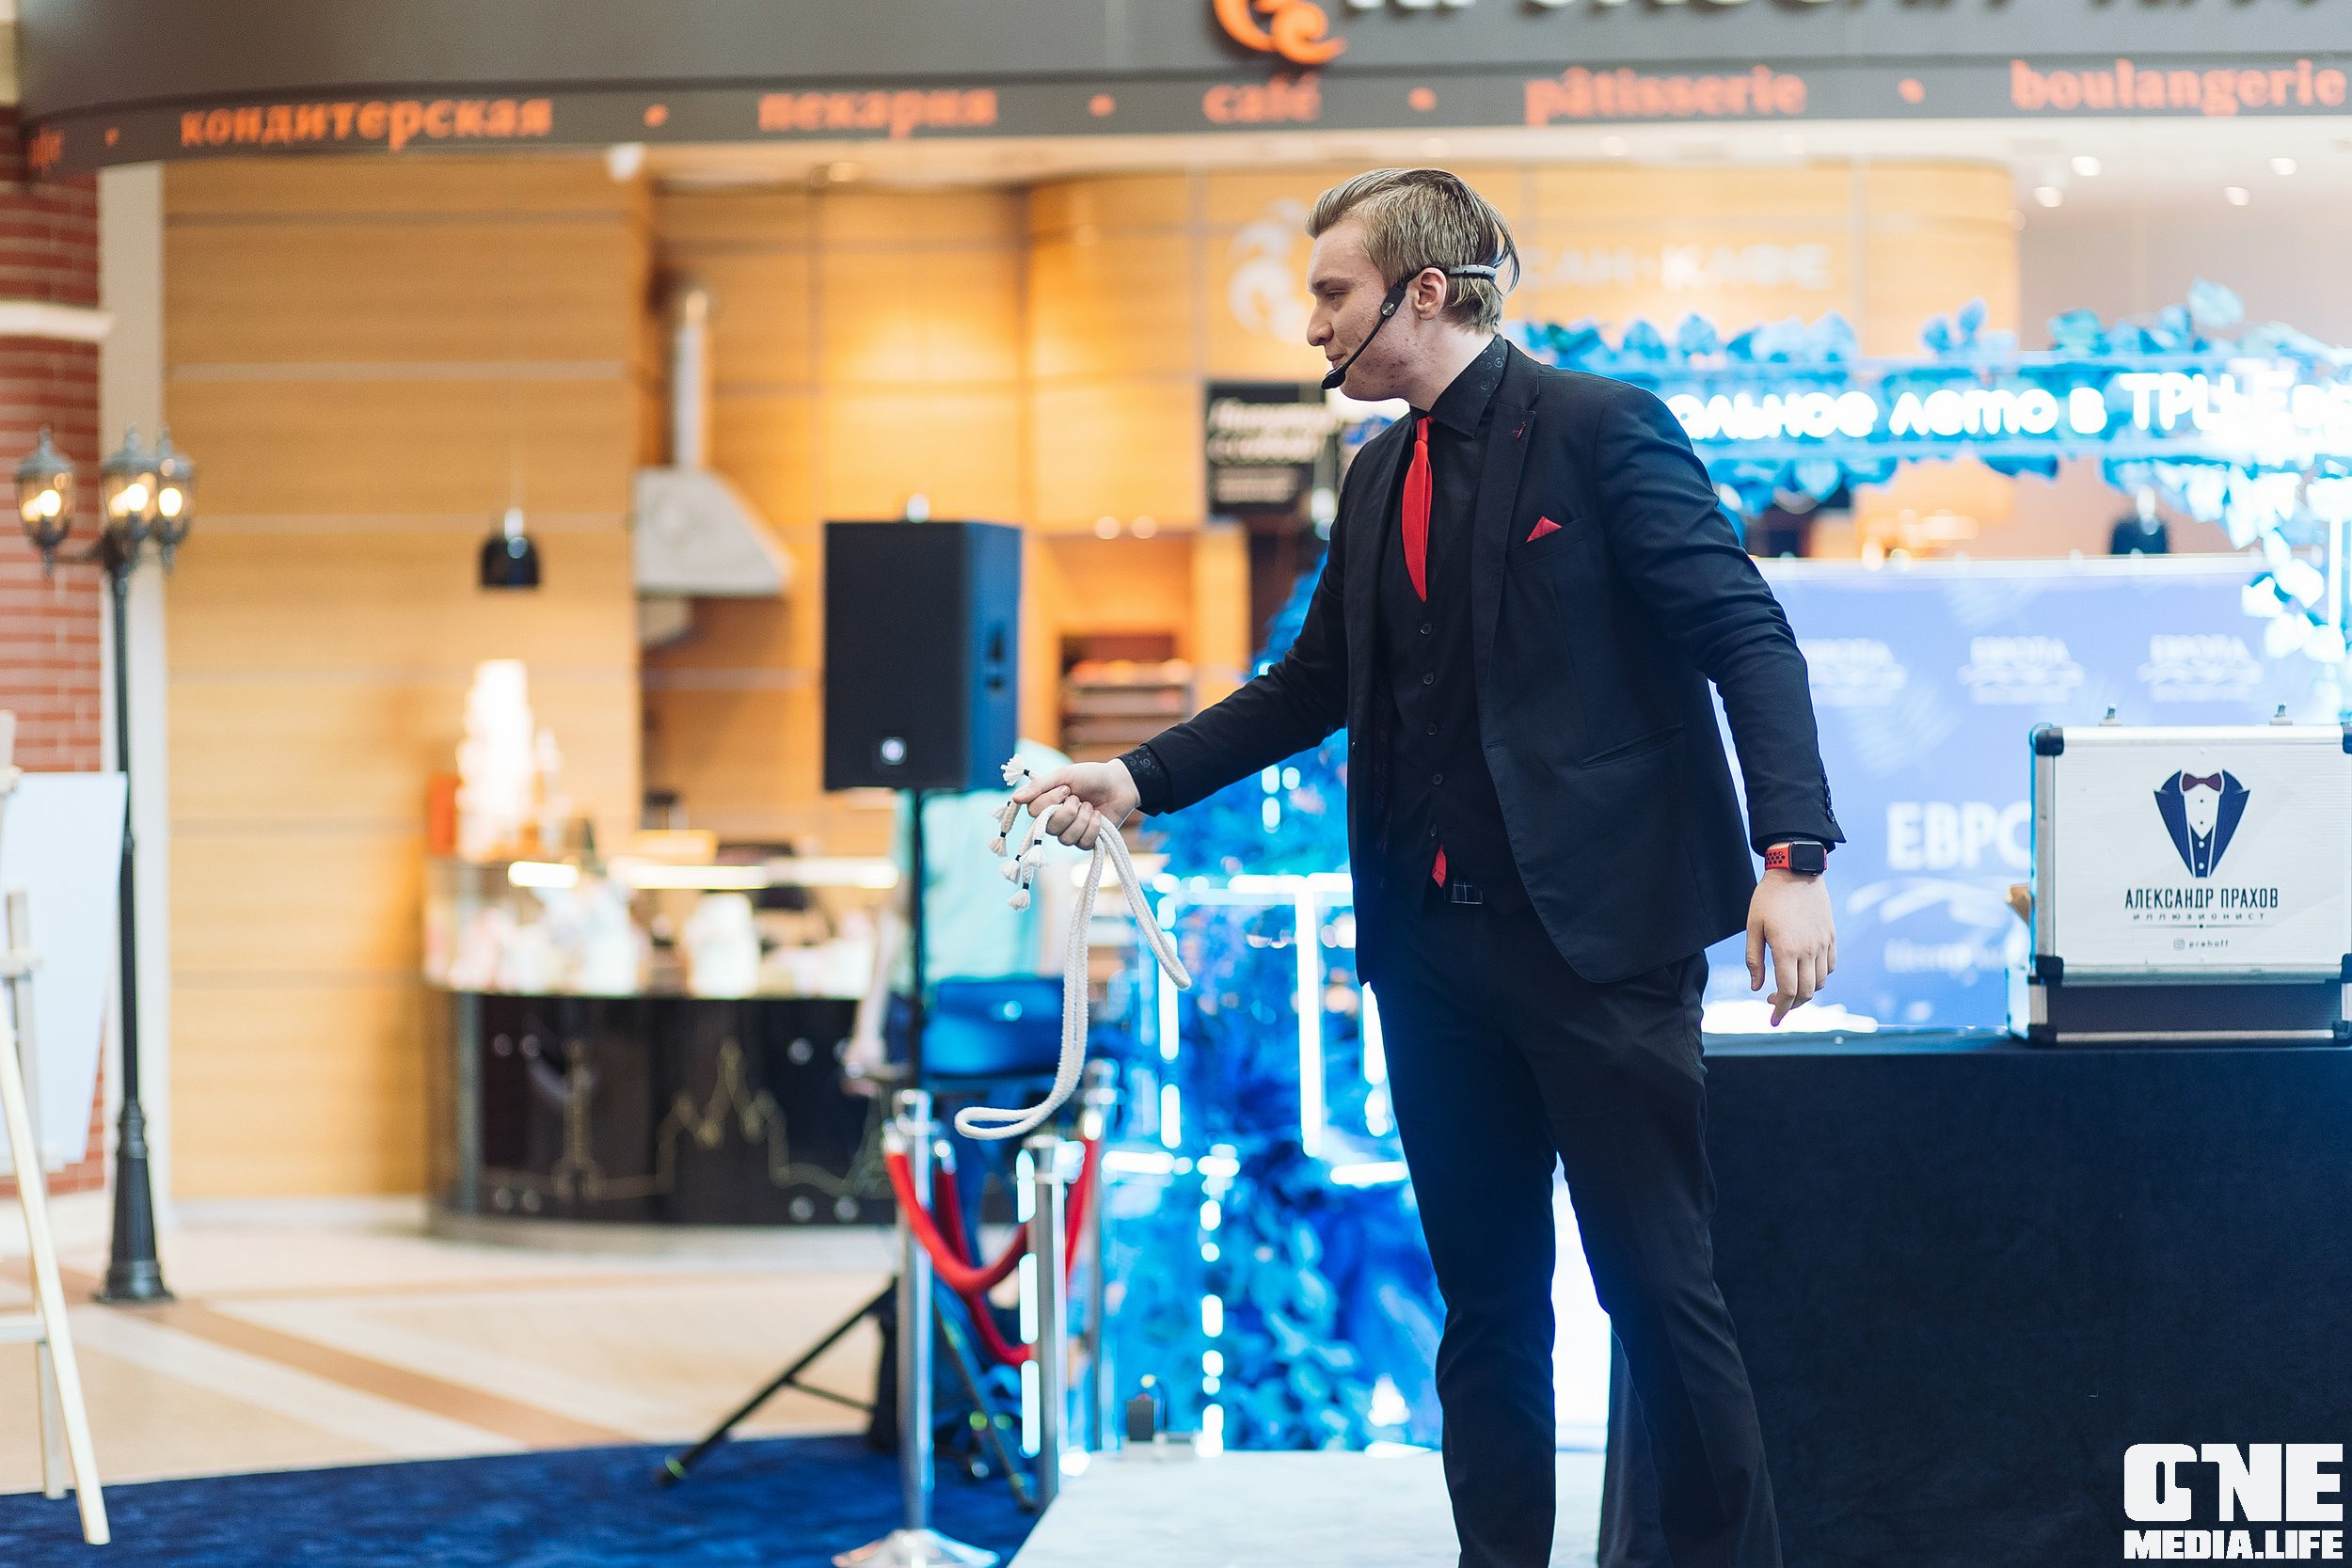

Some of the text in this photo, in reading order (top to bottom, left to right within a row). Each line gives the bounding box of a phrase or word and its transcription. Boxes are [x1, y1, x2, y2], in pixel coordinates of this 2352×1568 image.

[1202, 71, 1320, 125] café
[1524, 65, 1807, 126] pâtisserie
[2010, 58, 2347, 118] boulangerie
[181, 99, 553, 150] кондитерская
[2125, 888, 2279, 909] АЛЕКСАНДР ПРАХОВ
